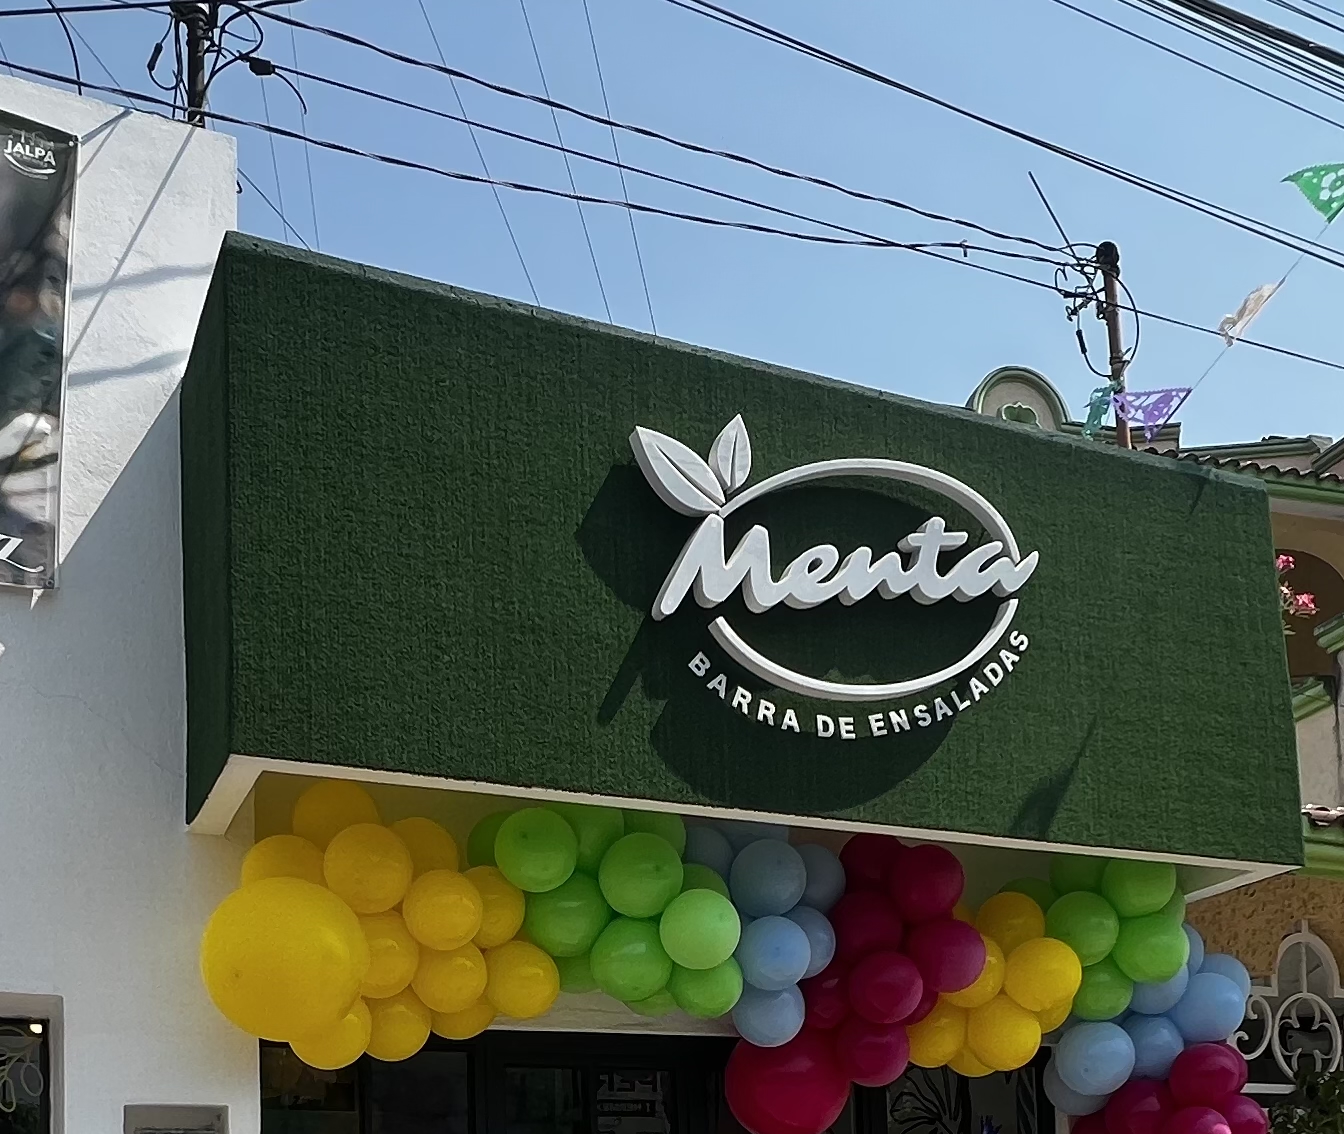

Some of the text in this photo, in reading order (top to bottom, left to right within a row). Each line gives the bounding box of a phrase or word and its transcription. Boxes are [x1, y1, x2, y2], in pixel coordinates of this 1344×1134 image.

[3, 139, 56, 168] JALPA
[652, 512, 1039, 621] Menta
[688, 630, 1030, 740] BARRA DE ENSALADAS
